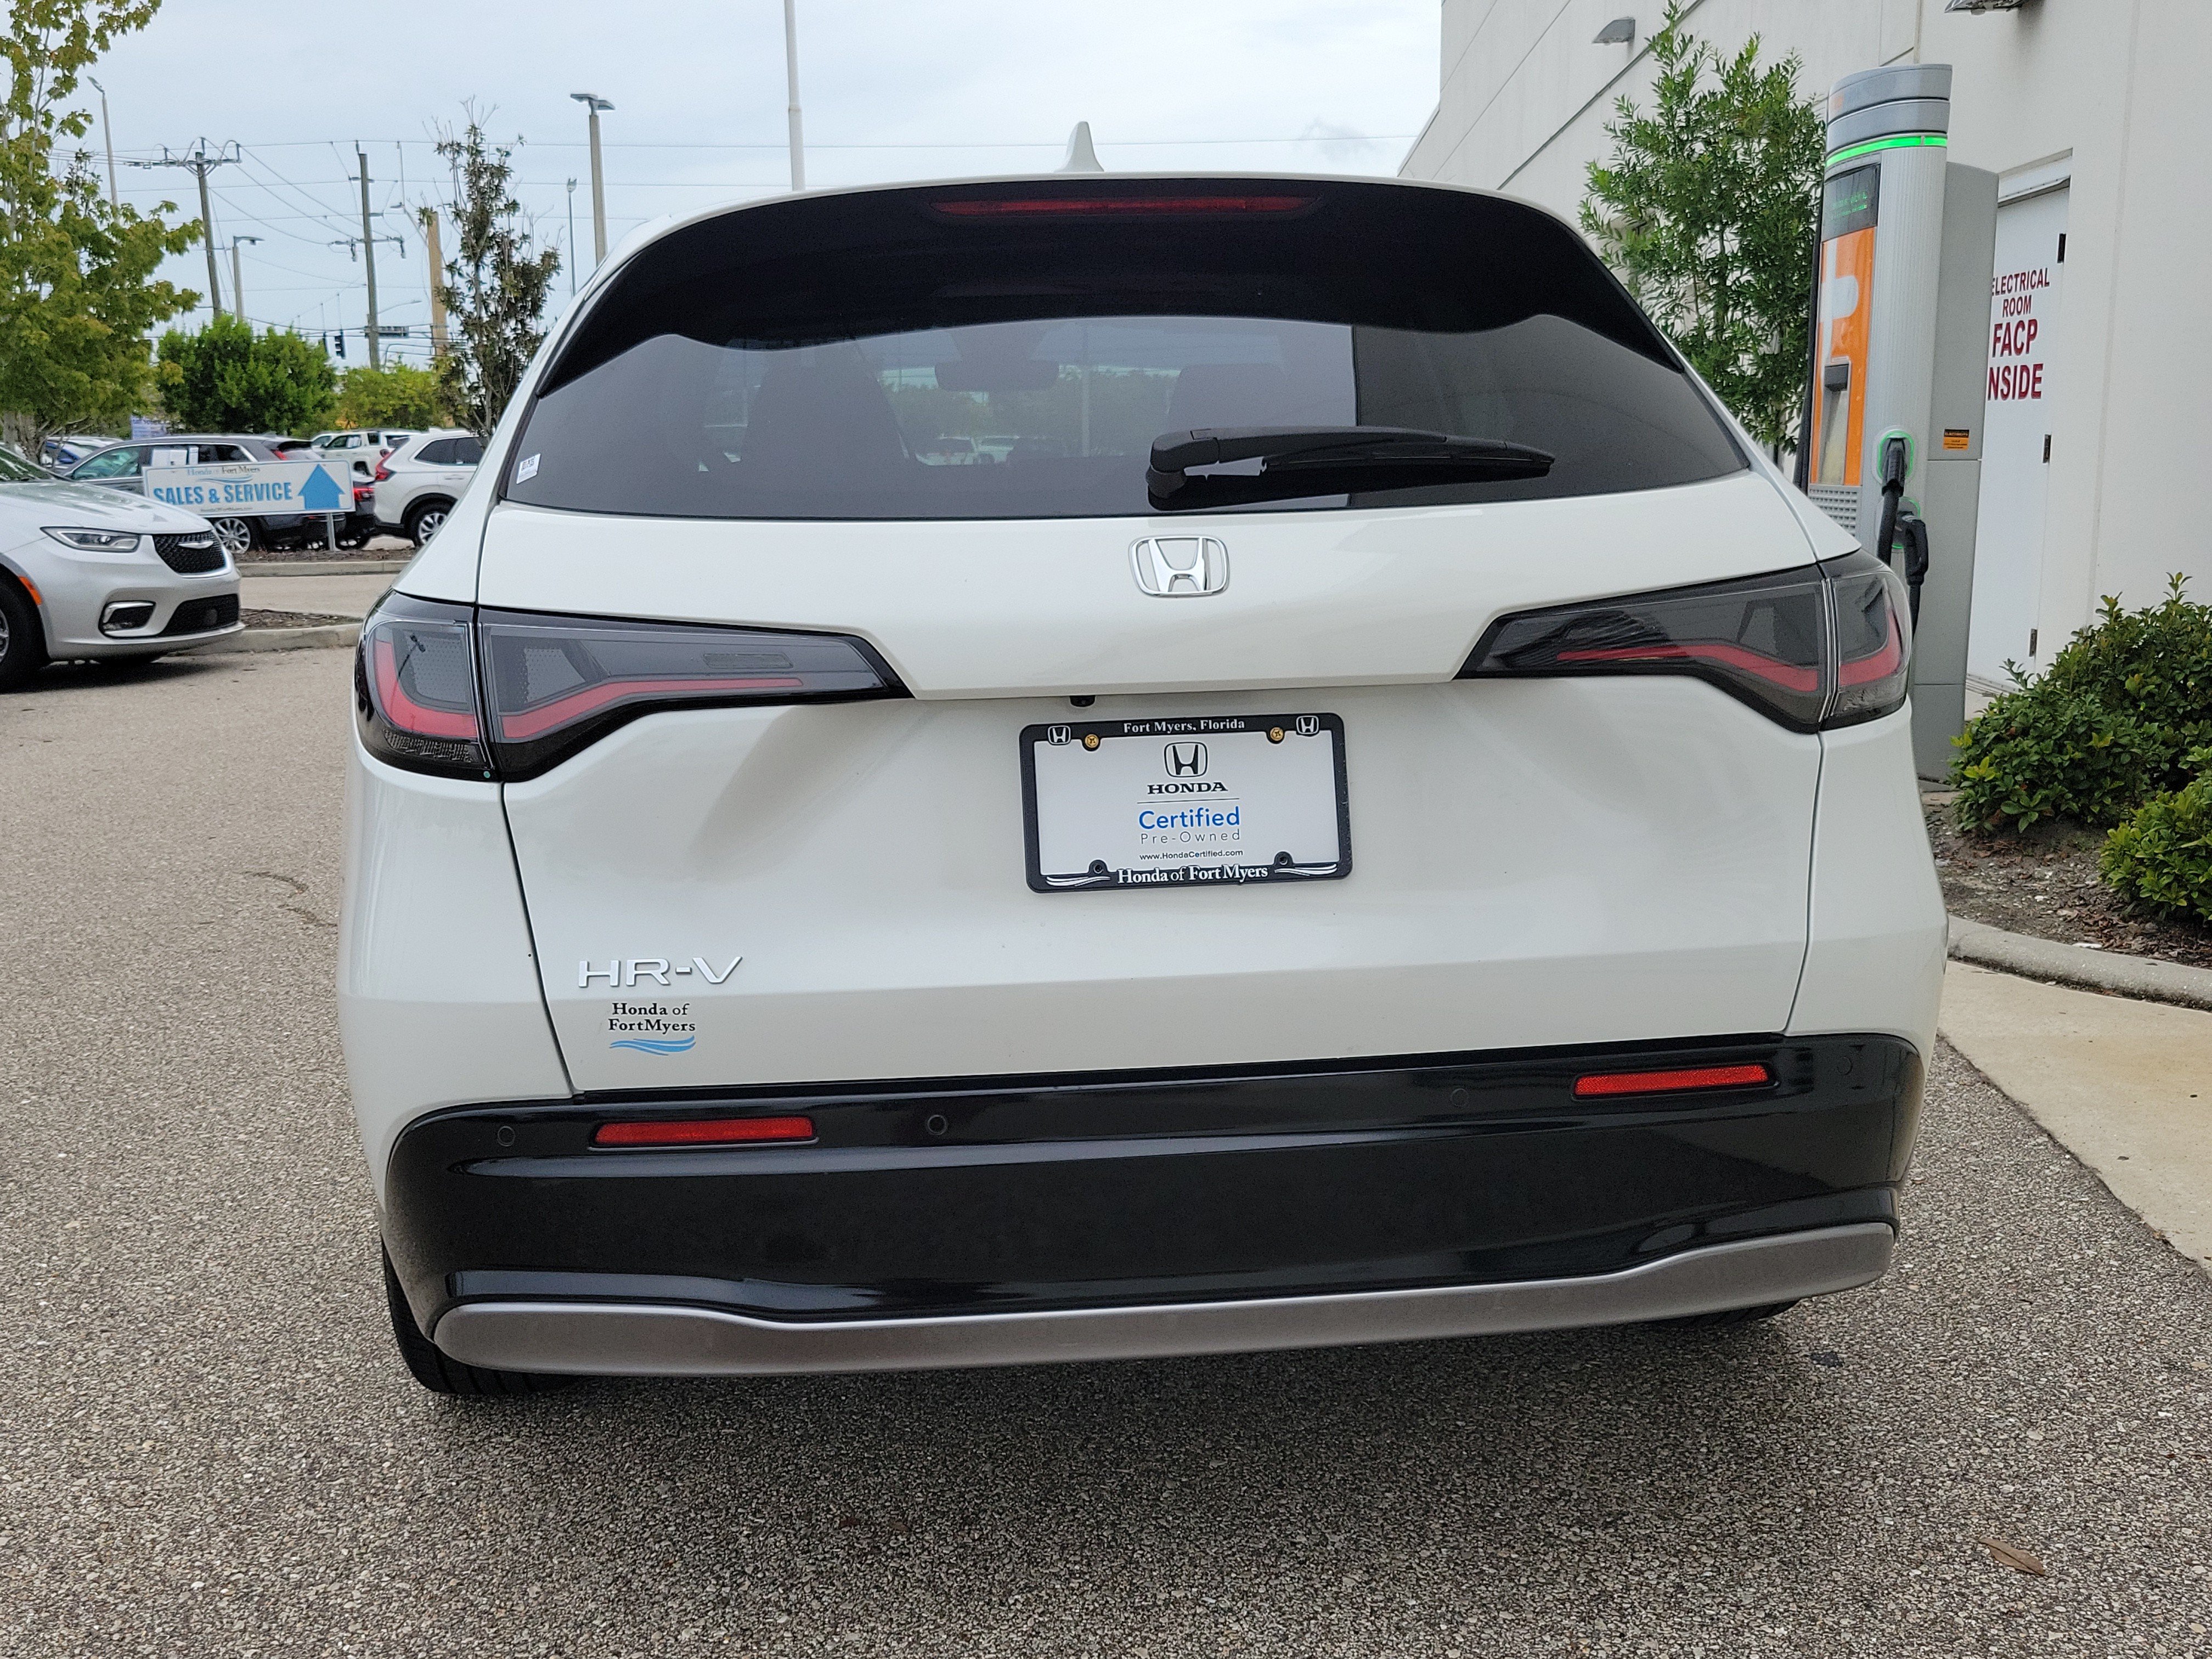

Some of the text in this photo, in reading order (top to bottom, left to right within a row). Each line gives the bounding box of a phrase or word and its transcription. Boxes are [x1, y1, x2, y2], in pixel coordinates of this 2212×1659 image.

[2002, 295, 2032, 318] ROOM
[1992, 318, 2038, 358] FACP
[1987, 363, 2044, 401] NSIDE
[153, 482, 292, 505] SALES & SERVICE
[1124, 719, 1245, 733] Fort Myers, Florida
[1147, 782, 1228, 795] HONDA
[1139, 805, 1240, 830] Certified
[1141, 829, 1240, 845] Pre-Owned
[1139, 850, 1244, 861] www.HondaCertified.com
[1118, 867, 1169, 884] Honda
[1170, 866, 1187, 881] of
[578, 956, 743, 988] HR-V
[612, 1002, 690, 1015] Honda of
